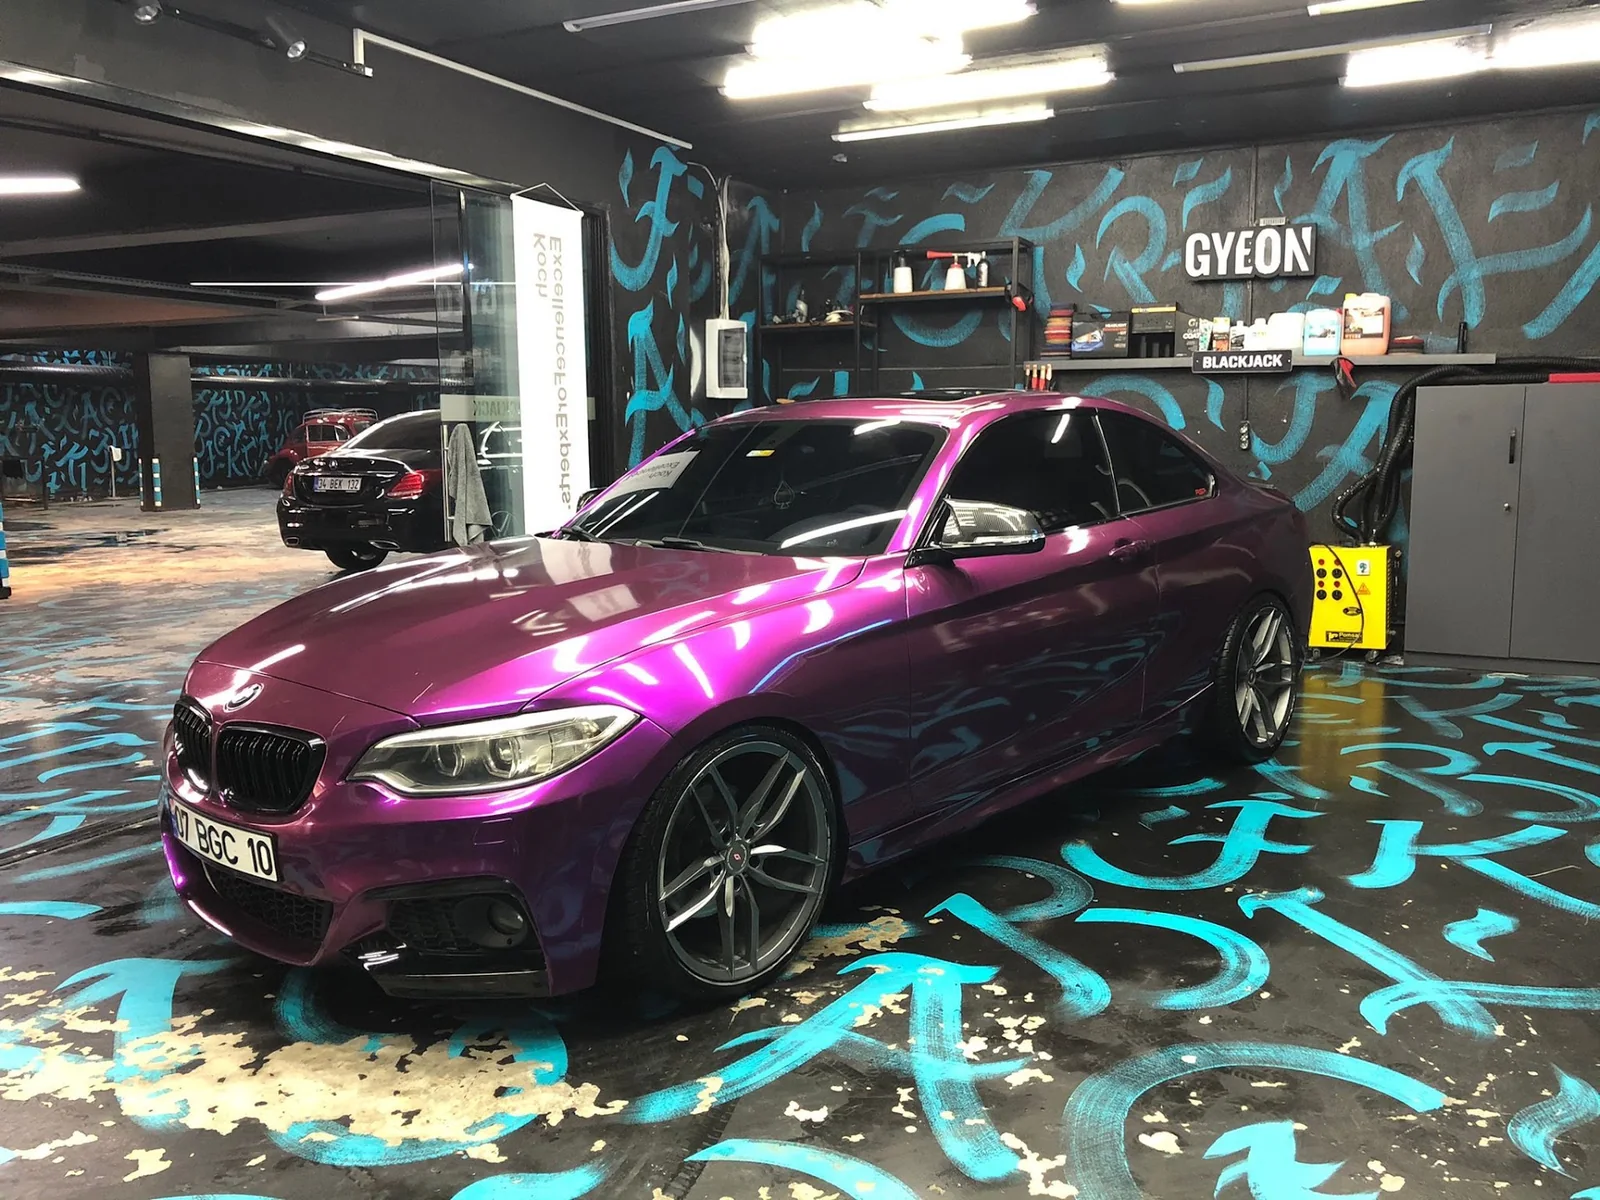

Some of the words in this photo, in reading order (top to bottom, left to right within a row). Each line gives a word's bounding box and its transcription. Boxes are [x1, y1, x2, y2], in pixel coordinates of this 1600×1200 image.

[1185, 226, 1313, 278] GYEON
[1202, 354, 1283, 369] BLACKJACK
[174, 805, 189, 842] 07
[195, 818, 239, 865] BGC
[247, 837, 273, 876] 10
